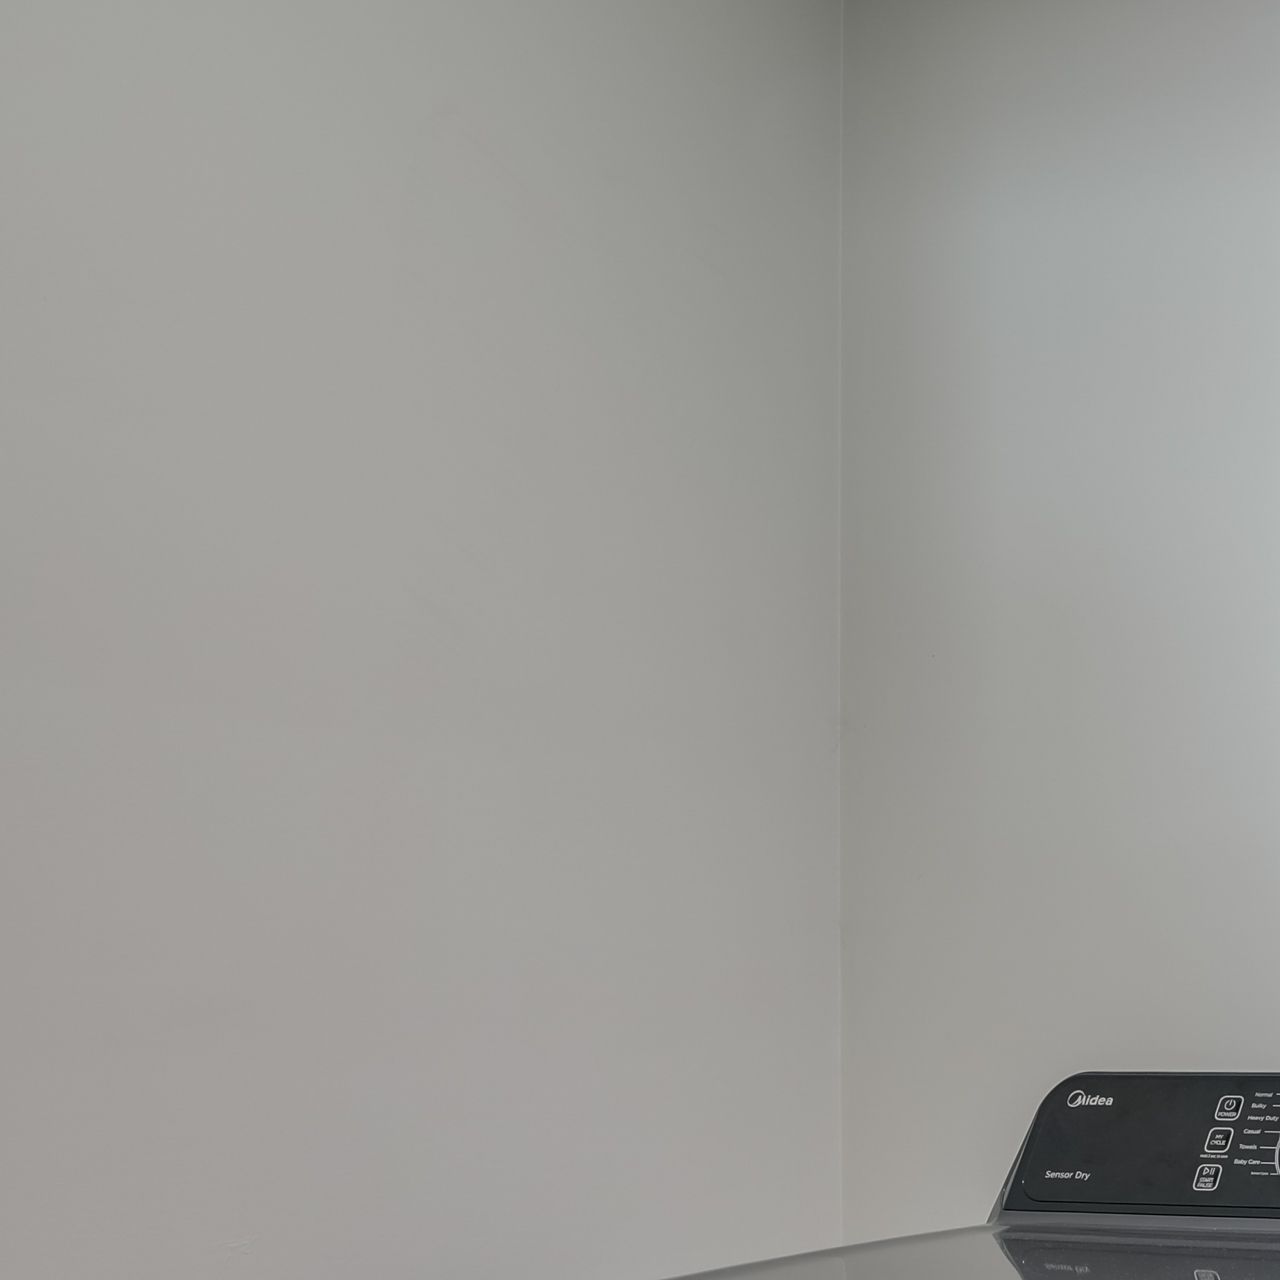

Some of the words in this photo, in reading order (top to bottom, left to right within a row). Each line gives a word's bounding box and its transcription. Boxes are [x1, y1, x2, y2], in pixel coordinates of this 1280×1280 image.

[1067, 1090, 1113, 1107] Midea
[1044, 1170, 1073, 1179] Sensor
[1074, 1171, 1091, 1181] Dry
